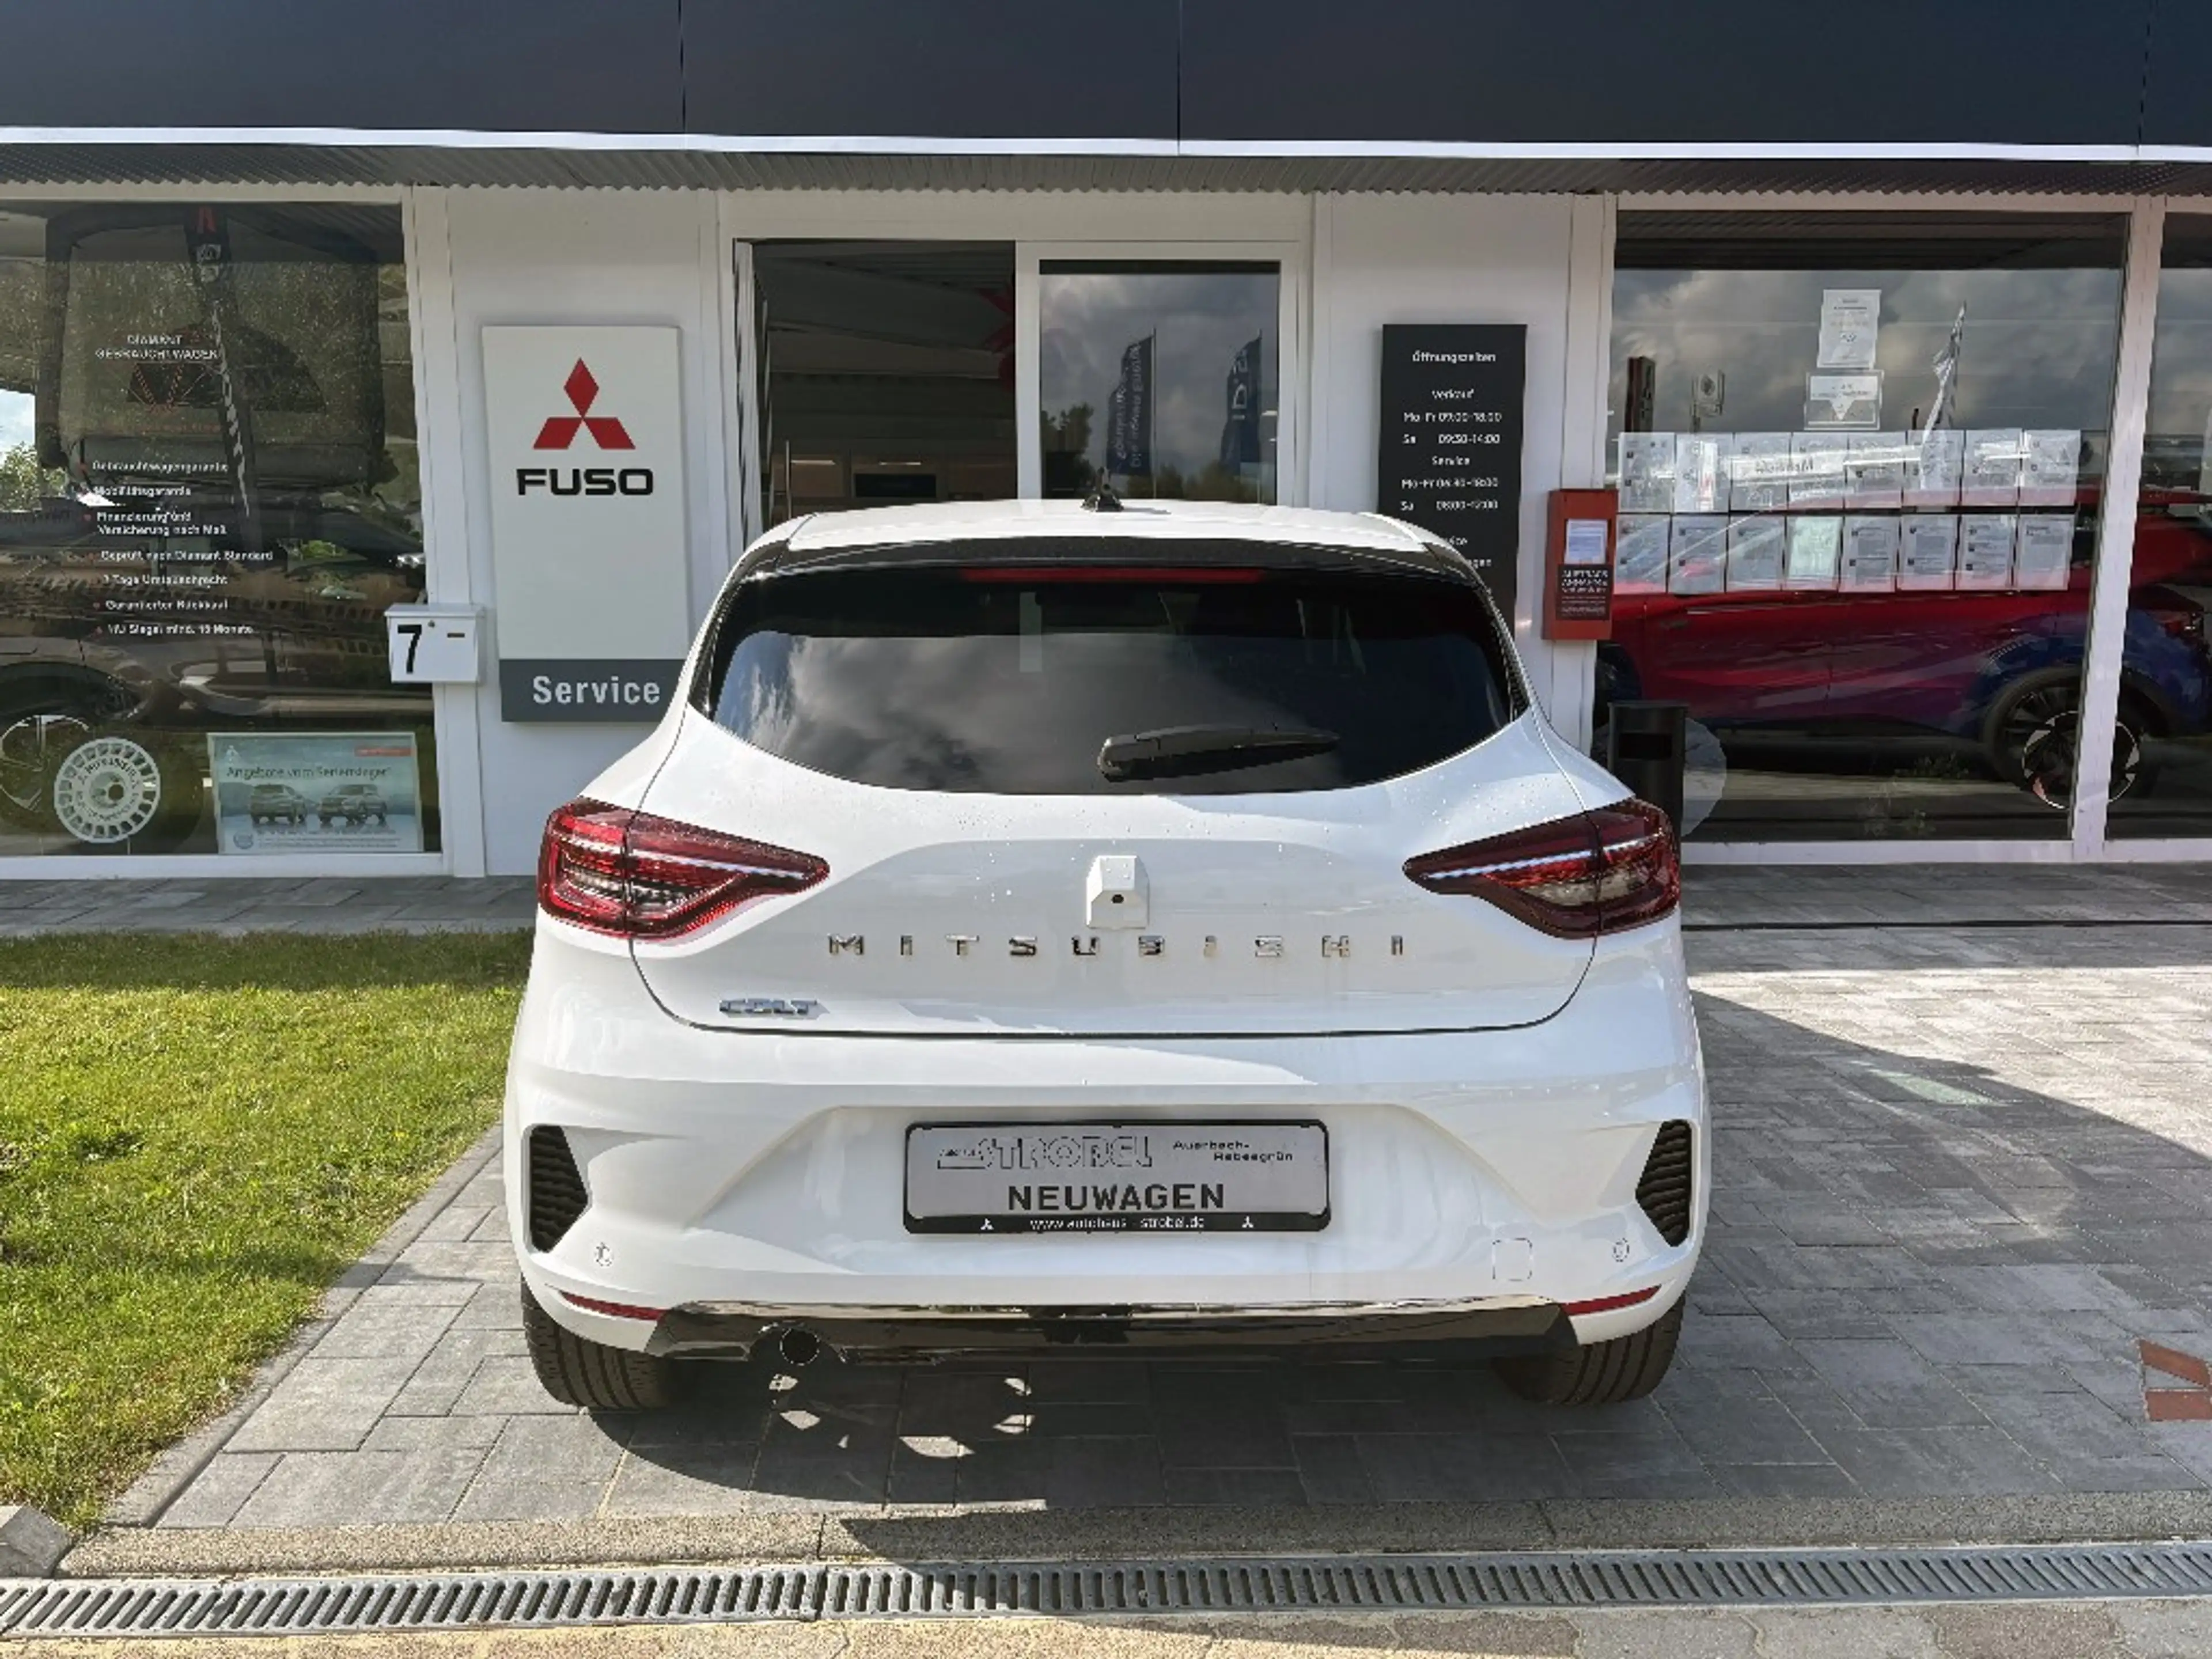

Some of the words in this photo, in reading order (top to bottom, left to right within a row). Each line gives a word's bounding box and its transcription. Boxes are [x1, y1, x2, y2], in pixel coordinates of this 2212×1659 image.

[1432, 456, 1470, 465] Service
[517, 468, 654, 496] FUSO
[397, 624, 422, 673] 7
[533, 676, 661, 705] Service
[827, 934, 1405, 959] MITSUBISHI
[1008, 1183, 1224, 1210] NEUWAGEN
